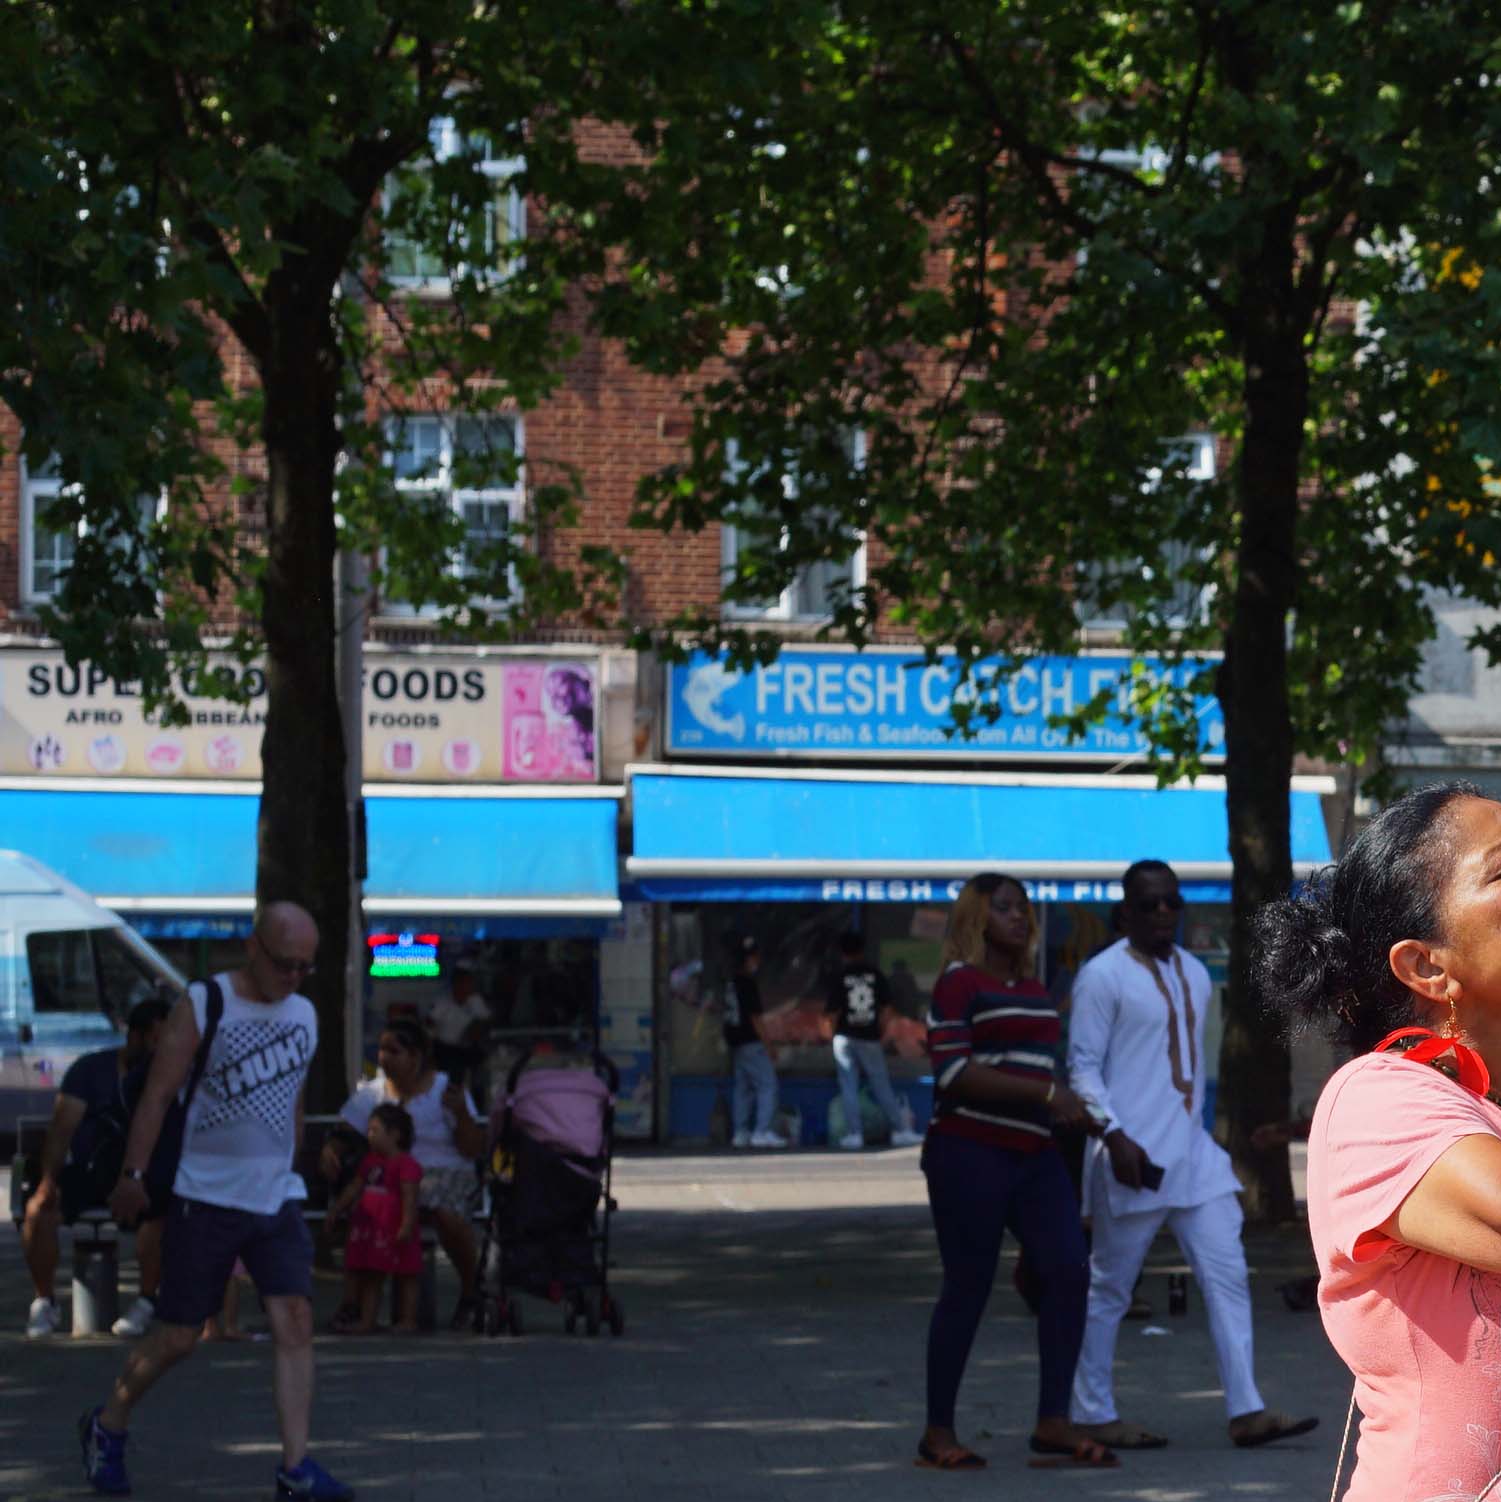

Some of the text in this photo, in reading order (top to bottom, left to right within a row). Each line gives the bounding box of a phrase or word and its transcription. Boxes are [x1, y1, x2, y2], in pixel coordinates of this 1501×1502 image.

[28, 665, 155, 697] SUPE
[363, 669, 486, 701] OODS
[756, 662, 907, 716] FRESH
[919, 663, 1074, 718] CATCH
[66, 708, 441, 728] AFRO CAIBBEAN FOODS
[755, 722, 809, 743] Fresh
[813, 722, 851, 743] Fish
[857, 723, 873, 743] &
[877, 723, 953, 744] Seafoo
[1011, 724, 1037, 745] All
[1040, 727, 1087, 747] Ovr
[1094, 726, 1130, 746] The
[822, 880, 932, 900] FRESH
[1073, 880, 1125, 900] FIS
[223, 1023, 310, 1098] HUH?
